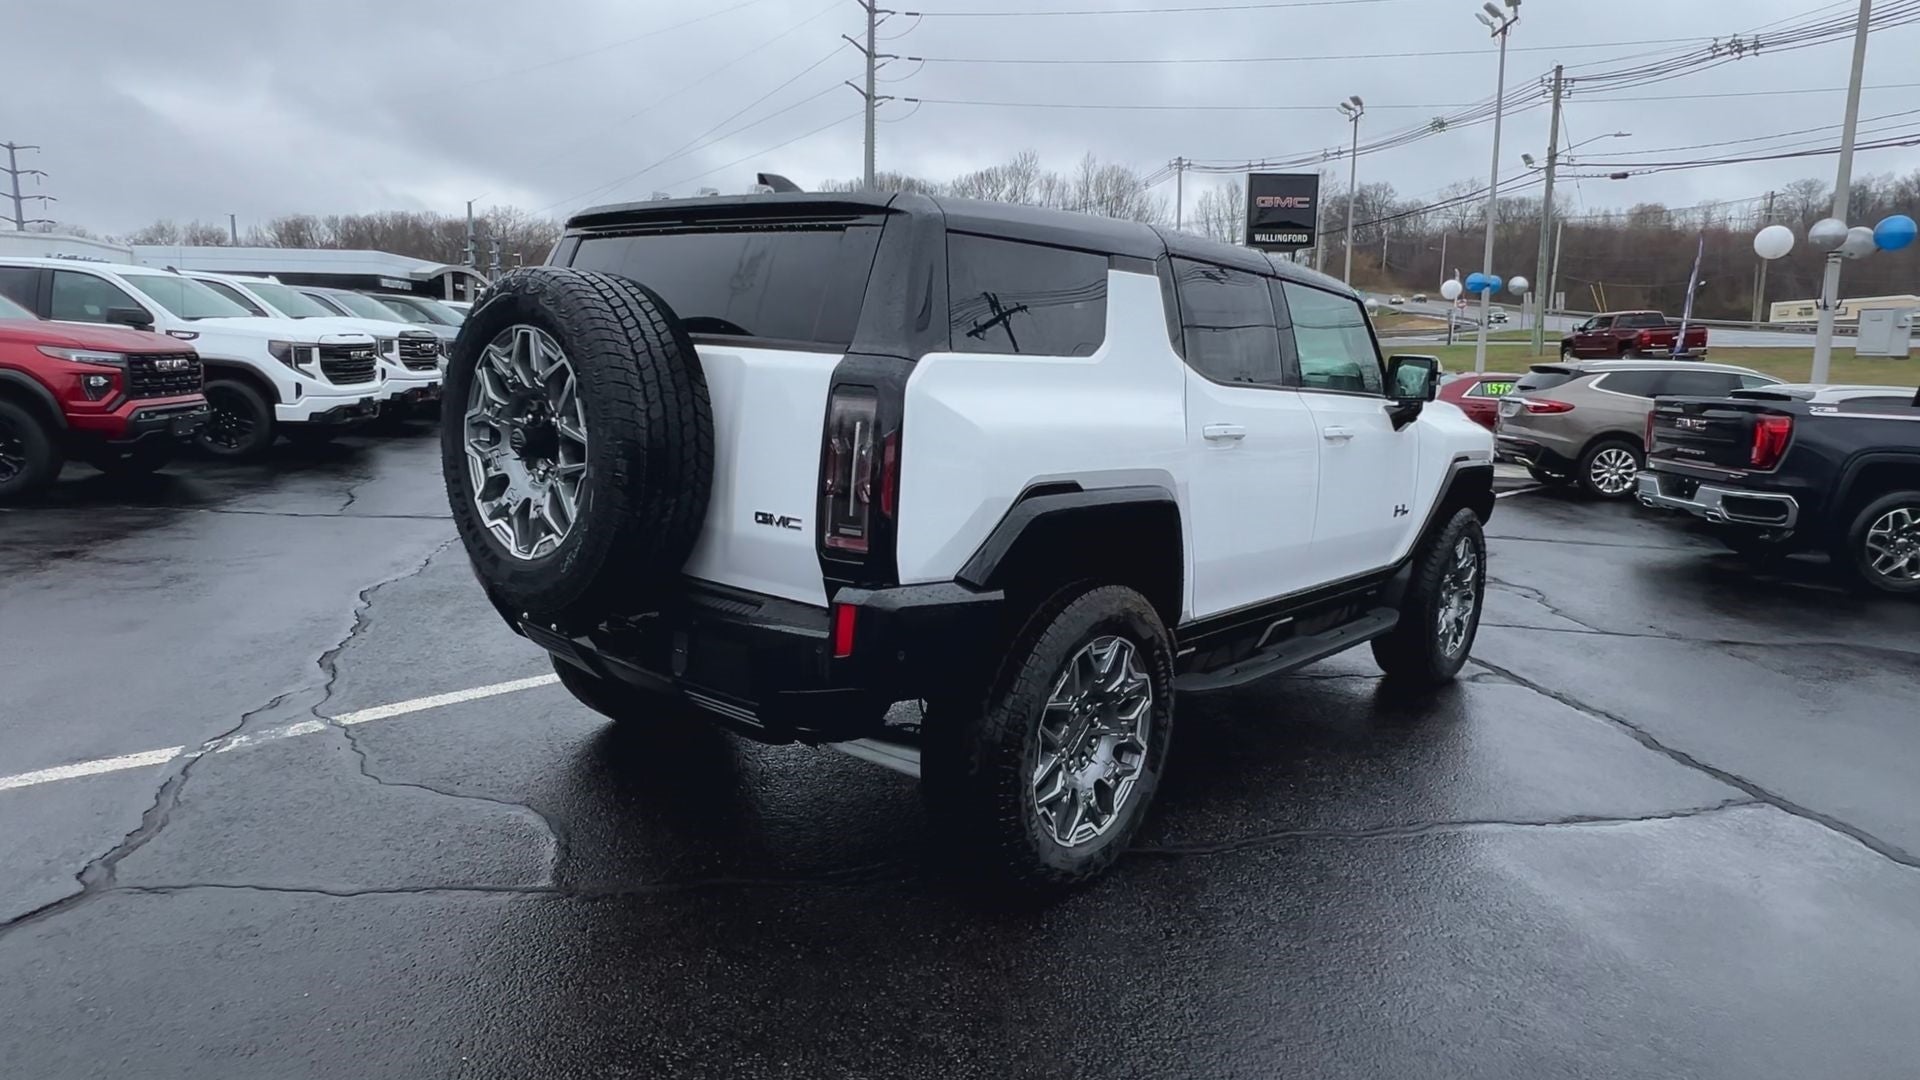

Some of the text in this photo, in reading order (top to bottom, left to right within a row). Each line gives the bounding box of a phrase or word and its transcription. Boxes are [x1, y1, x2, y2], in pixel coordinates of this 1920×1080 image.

[1256, 196, 1310, 208] GMC
[1254, 233, 1308, 243] WALLINGFORD
[754, 511, 802, 531] GMC
